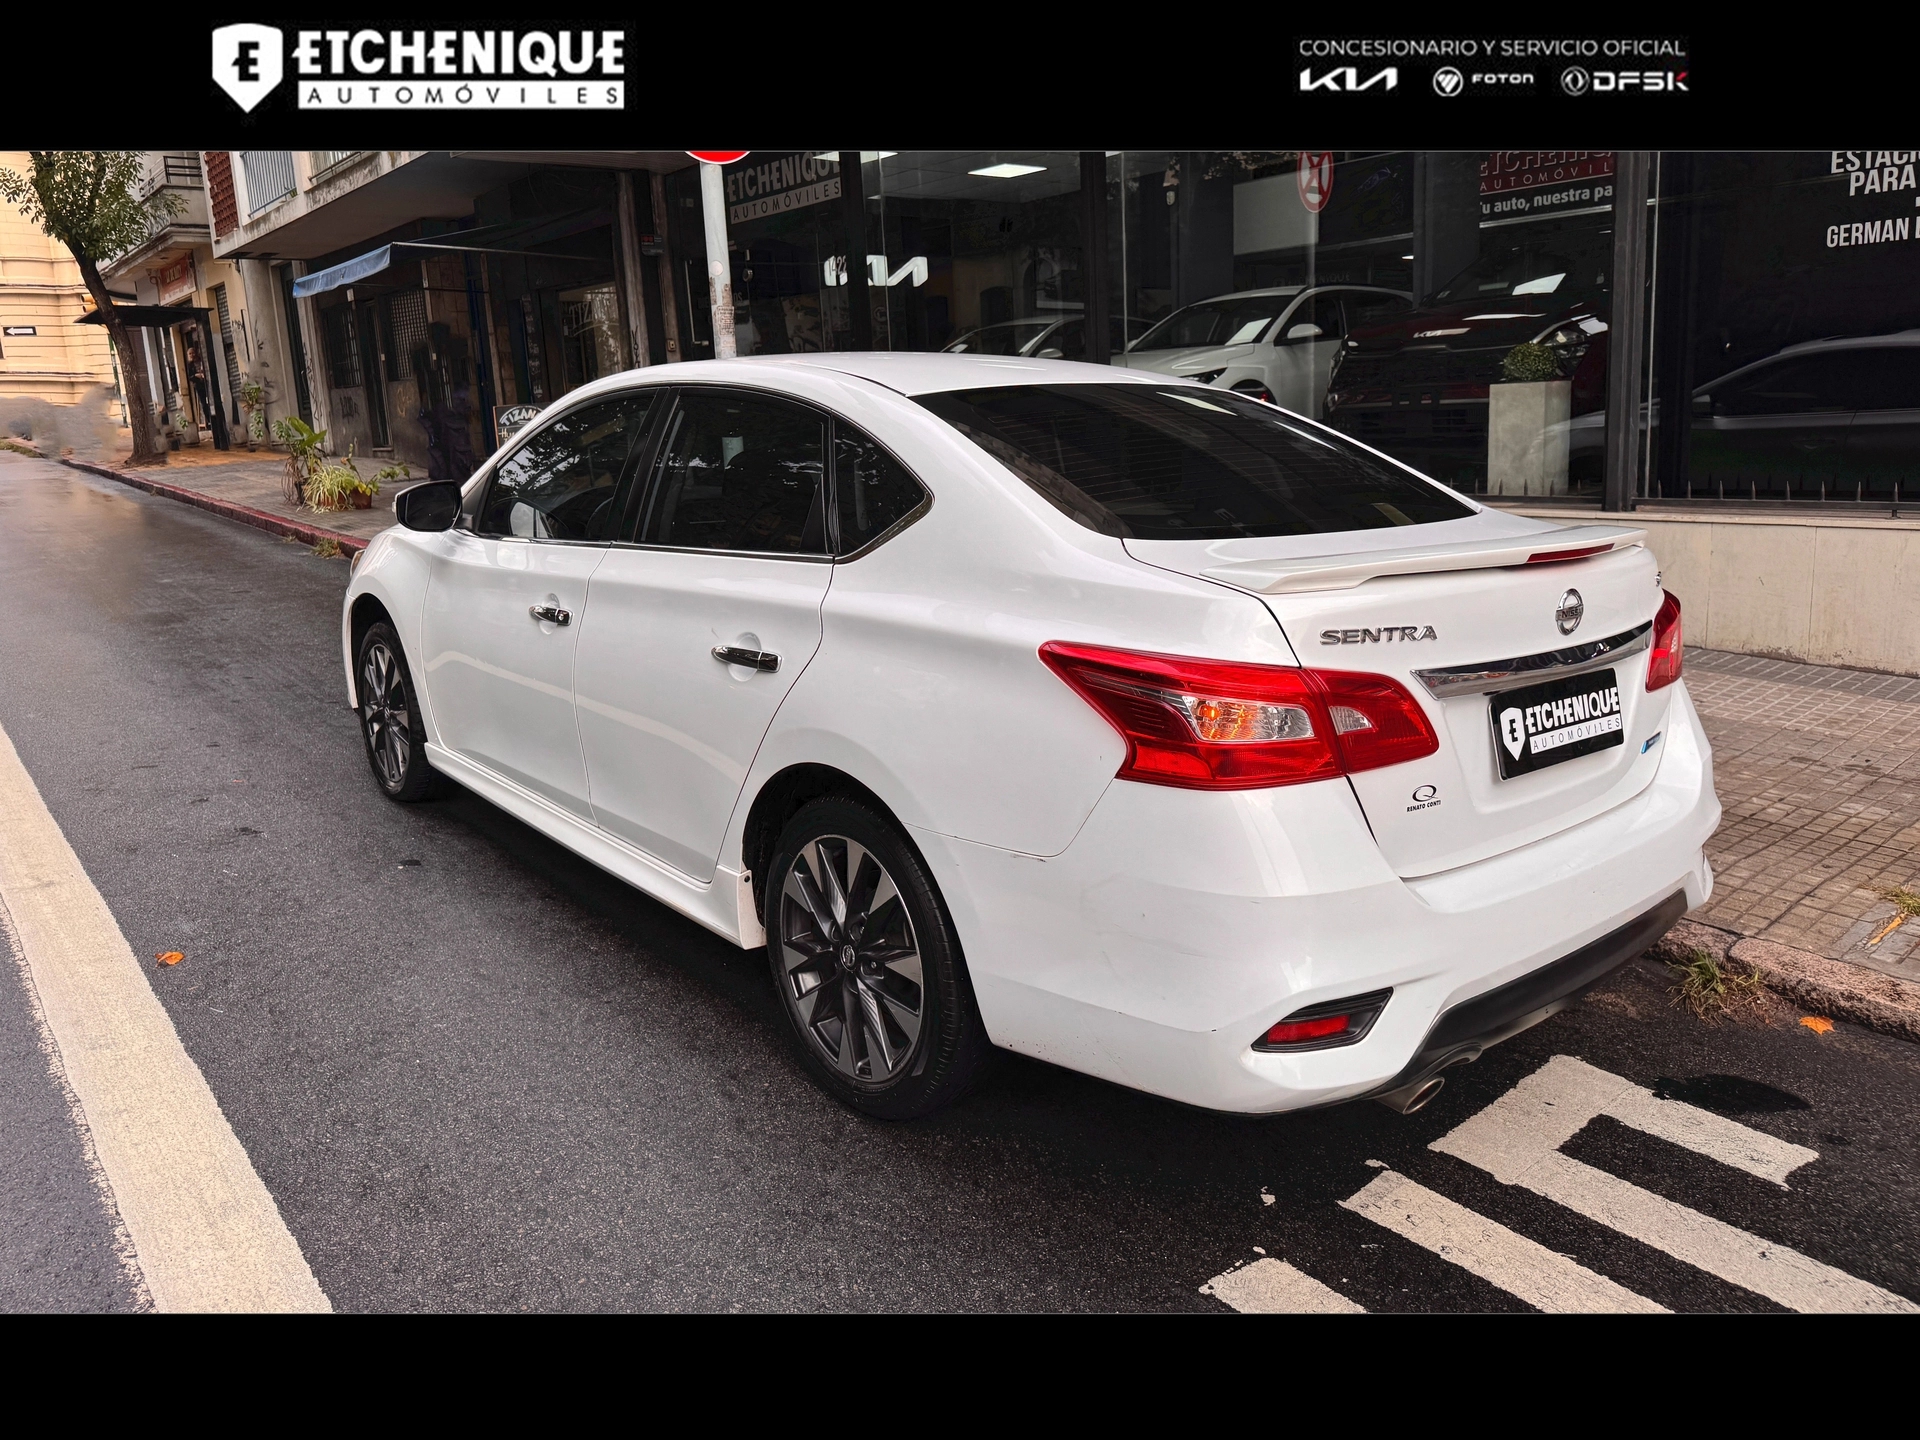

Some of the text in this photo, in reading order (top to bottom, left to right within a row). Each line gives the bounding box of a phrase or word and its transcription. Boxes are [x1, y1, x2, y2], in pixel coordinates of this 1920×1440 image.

[1849, 164, 1916, 197] PARA
[733, 181, 840, 221] AUTOMÓVILES
[1494, 197, 1530, 212] auto,
[1533, 188, 1590, 207] nuestra
[1826, 217, 1909, 248] GERMAN
[1320, 625, 1438, 645] SENTRA
[1526, 687, 1620, 734] ETCHENIQUE
[1533, 718, 1621, 750] AUTOMÓVILES
[1406, 803, 1426, 813] RENATO
